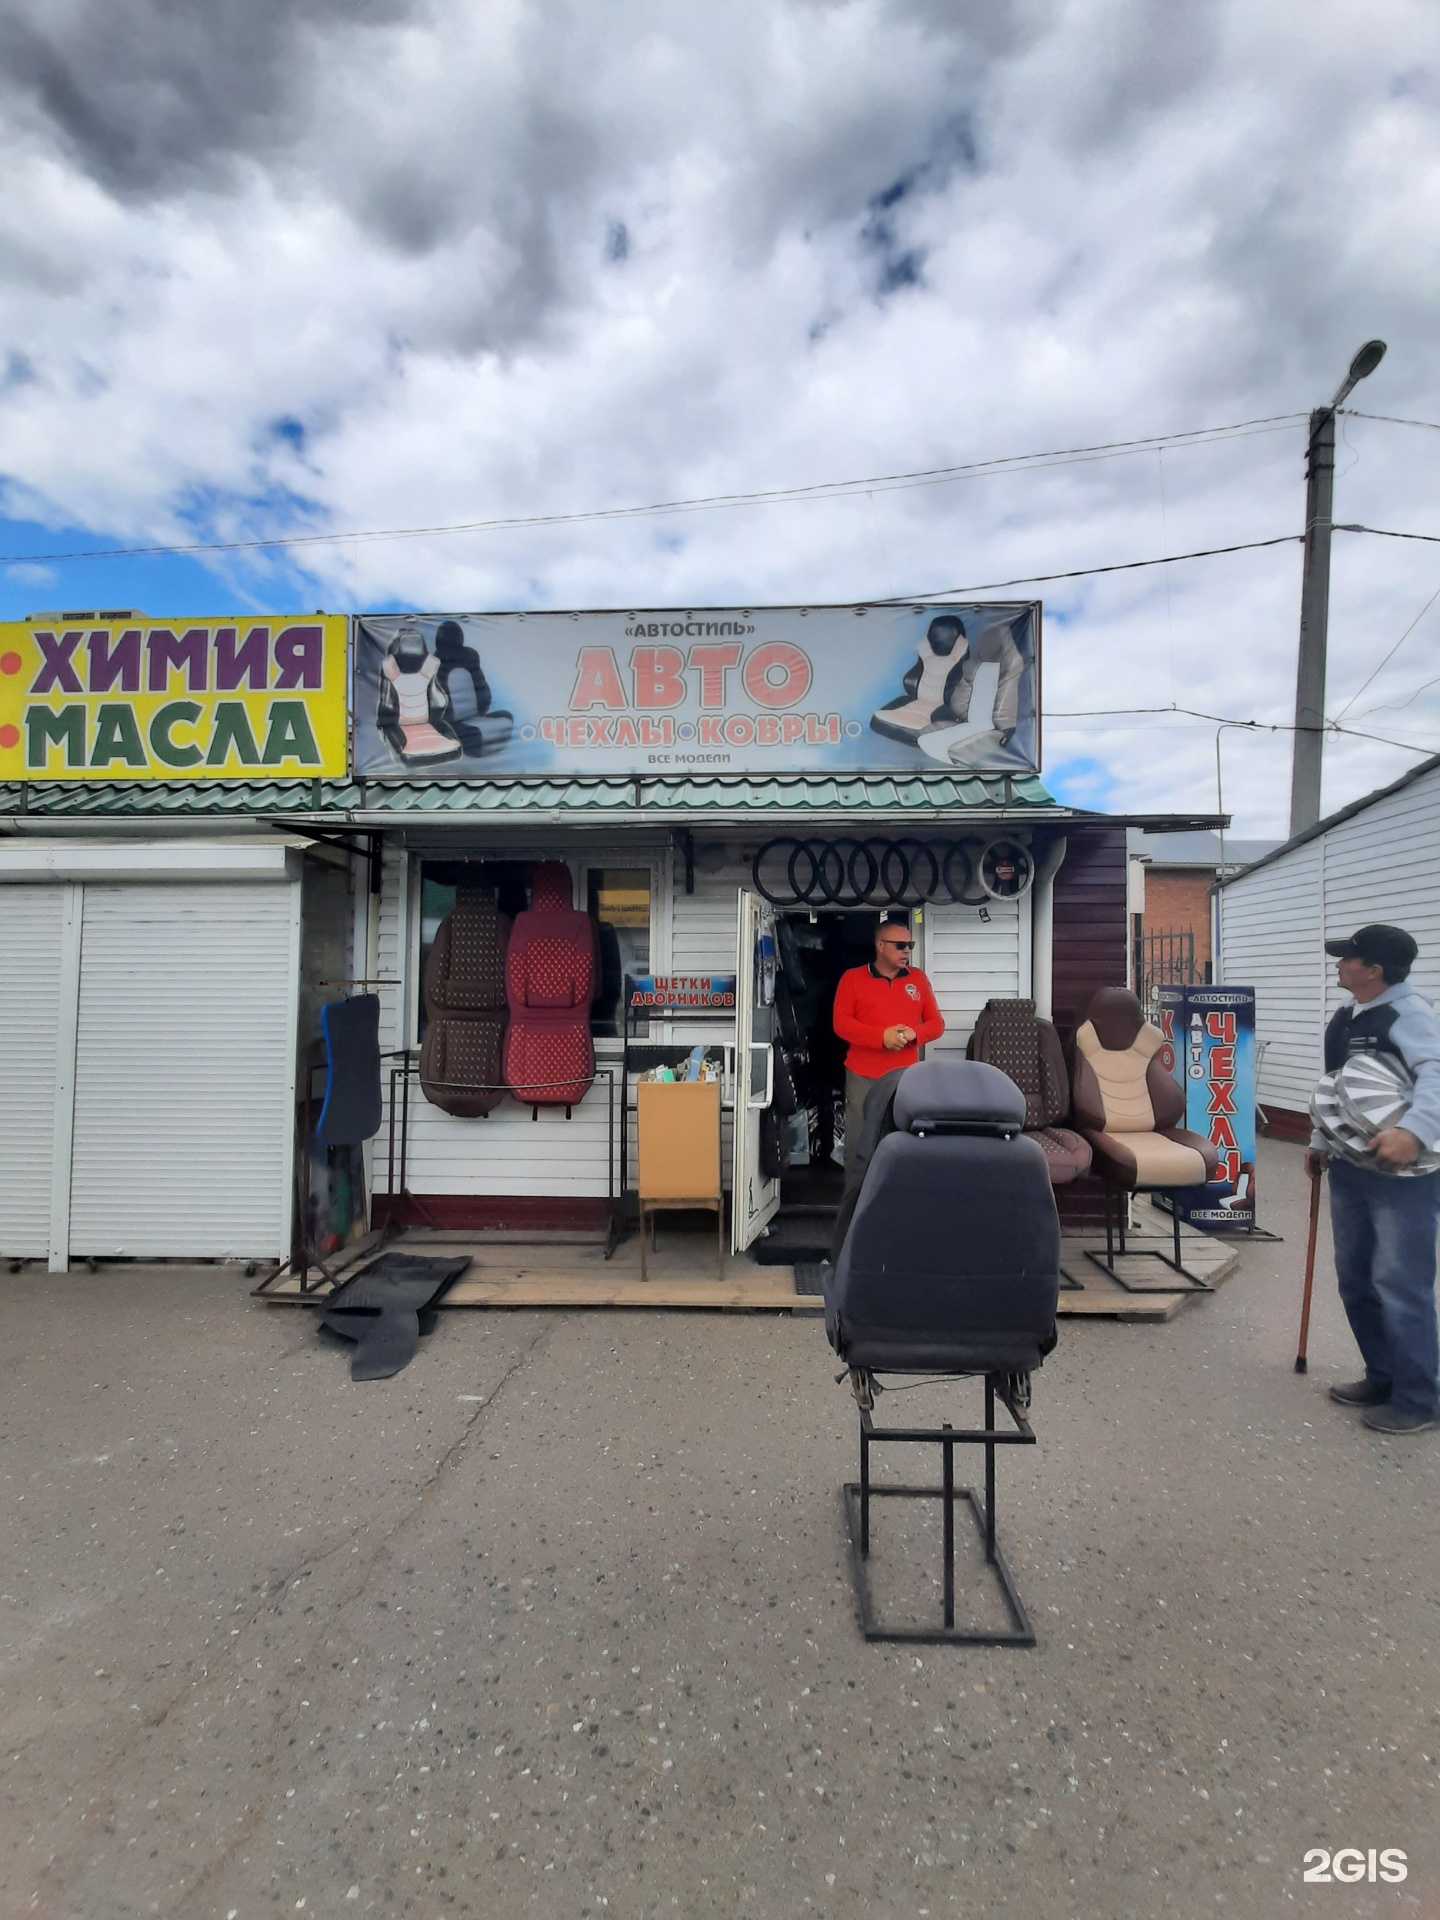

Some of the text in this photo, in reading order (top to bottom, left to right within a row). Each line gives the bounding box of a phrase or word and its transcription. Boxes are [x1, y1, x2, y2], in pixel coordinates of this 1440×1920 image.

[625, 621, 755, 637] «АВТОСТИЛЬ»
[28, 626, 324, 694] ХИМИЯ
[568, 641, 813, 711] АВТО
[24, 700, 322, 768] МАСЛА
[540, 713, 842, 748] ЧЕХЛЫ КОВРЫ
[647, 753, 731, 764] ВСЕ МОДЕЛИ
[654, 976, 712, 992] ЩЕТКИ
[631, 991, 735, 1007] ДВОРНИКОВ
